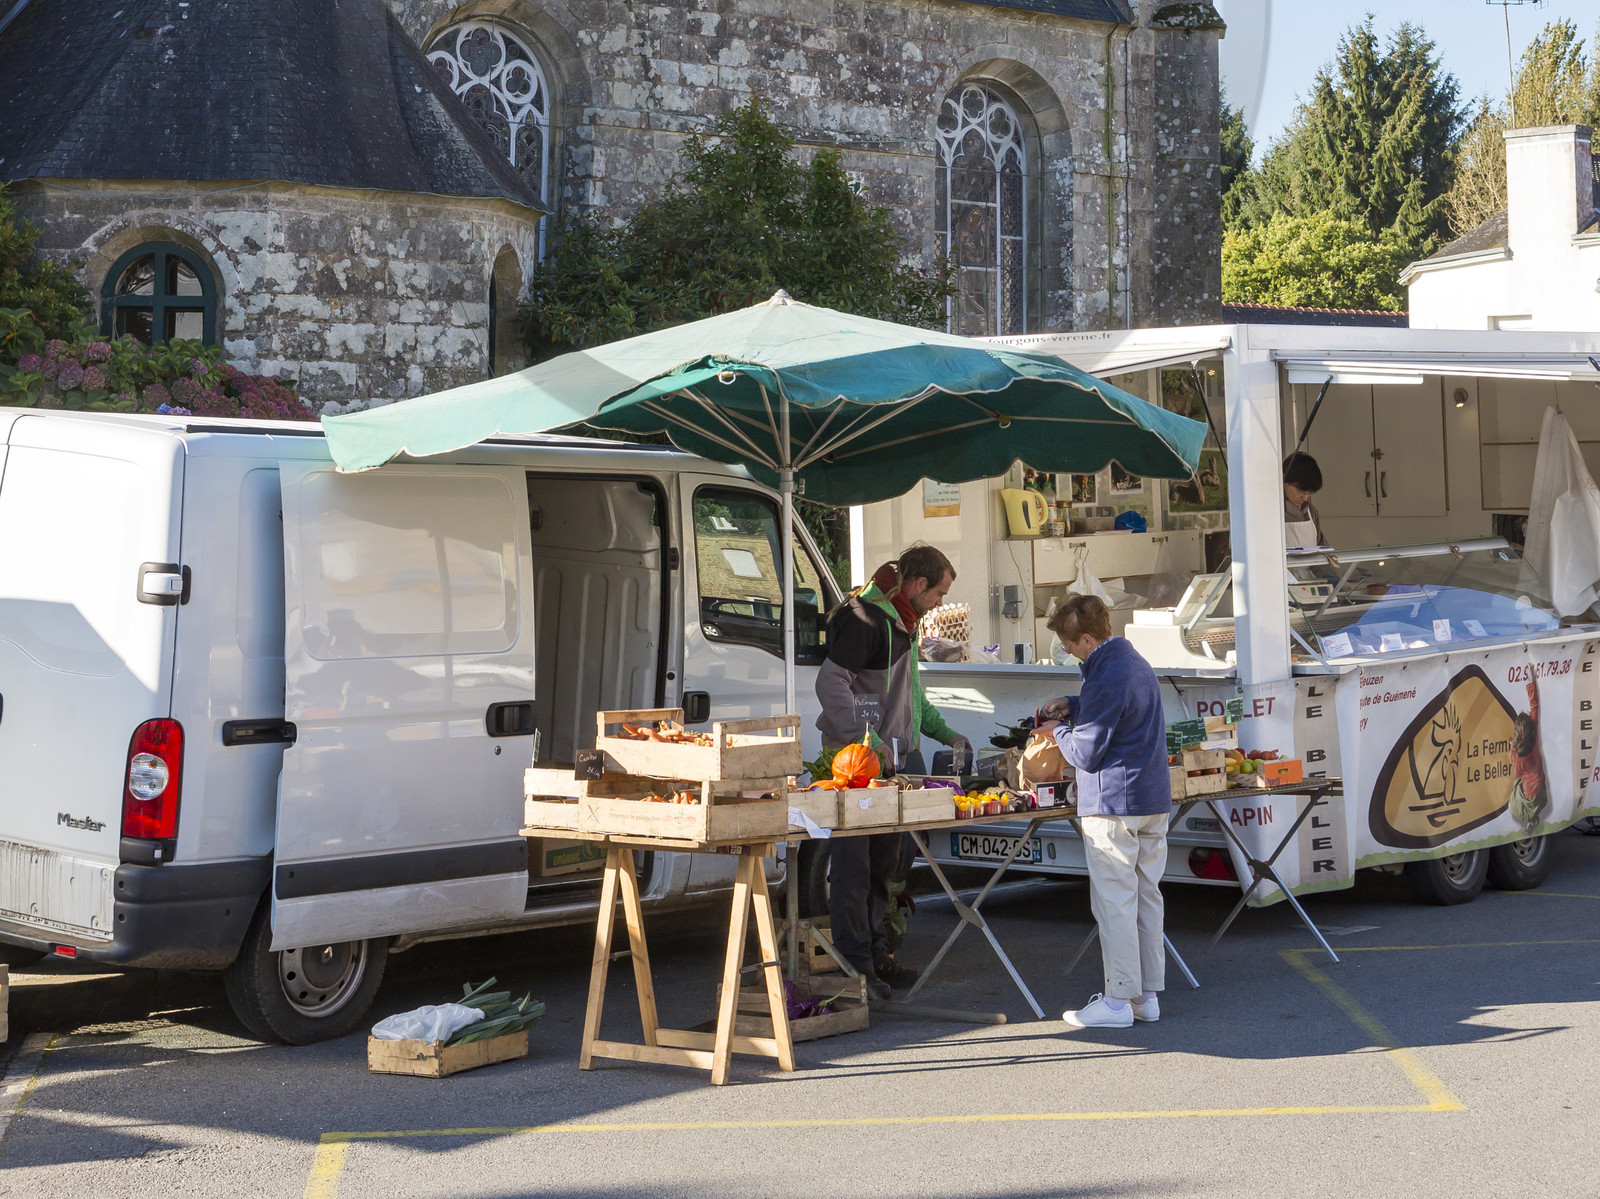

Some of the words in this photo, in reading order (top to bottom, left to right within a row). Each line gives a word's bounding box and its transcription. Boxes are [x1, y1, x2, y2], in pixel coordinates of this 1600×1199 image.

[1197, 696, 1276, 719] POET
[1306, 685, 1324, 719] LE
[1372, 693, 1382, 705] de
[1466, 742, 1479, 759] La
[1467, 766, 1481, 783] Le
[1484, 761, 1512, 781] Beller
[56, 810, 107, 832] Master
[1230, 804, 1273, 827] APIN
